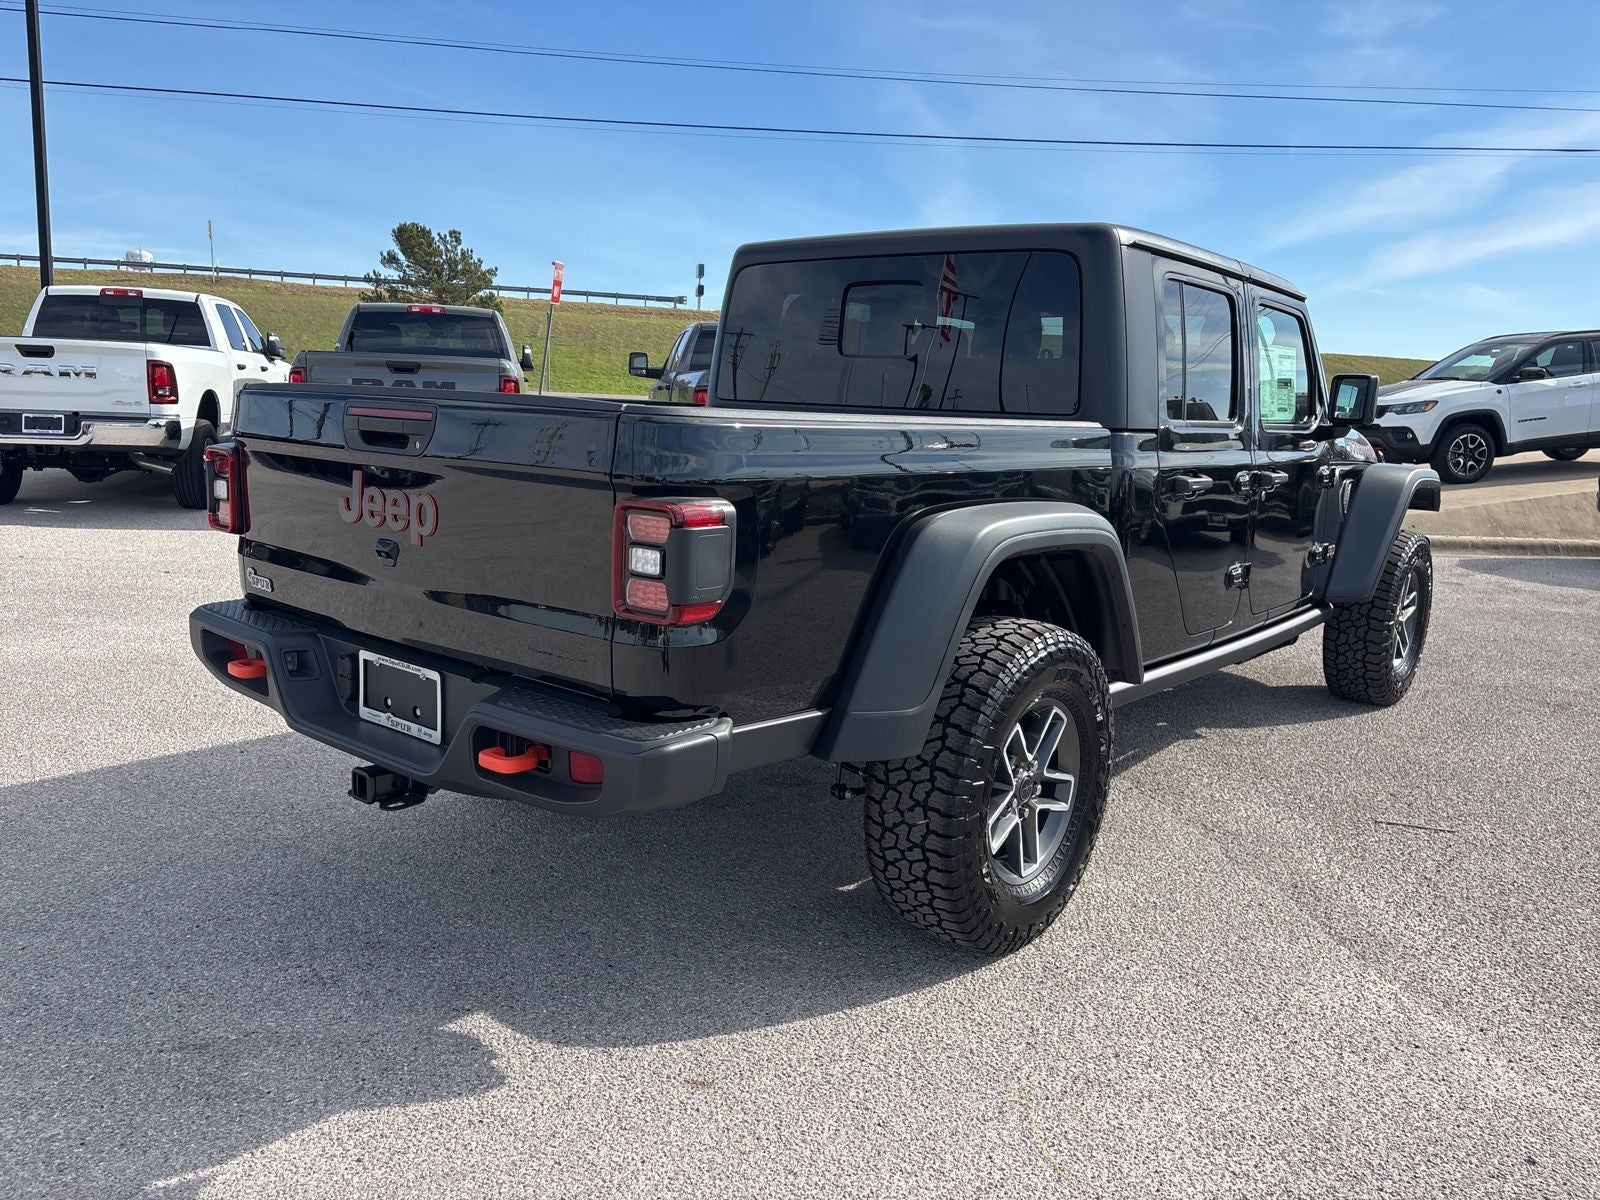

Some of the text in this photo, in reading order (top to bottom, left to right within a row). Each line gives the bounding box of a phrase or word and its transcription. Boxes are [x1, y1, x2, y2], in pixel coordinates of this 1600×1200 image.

[337, 470, 439, 547] Jeep
[251, 576, 270, 590] SPUR
[390, 719, 412, 732] SPUR
